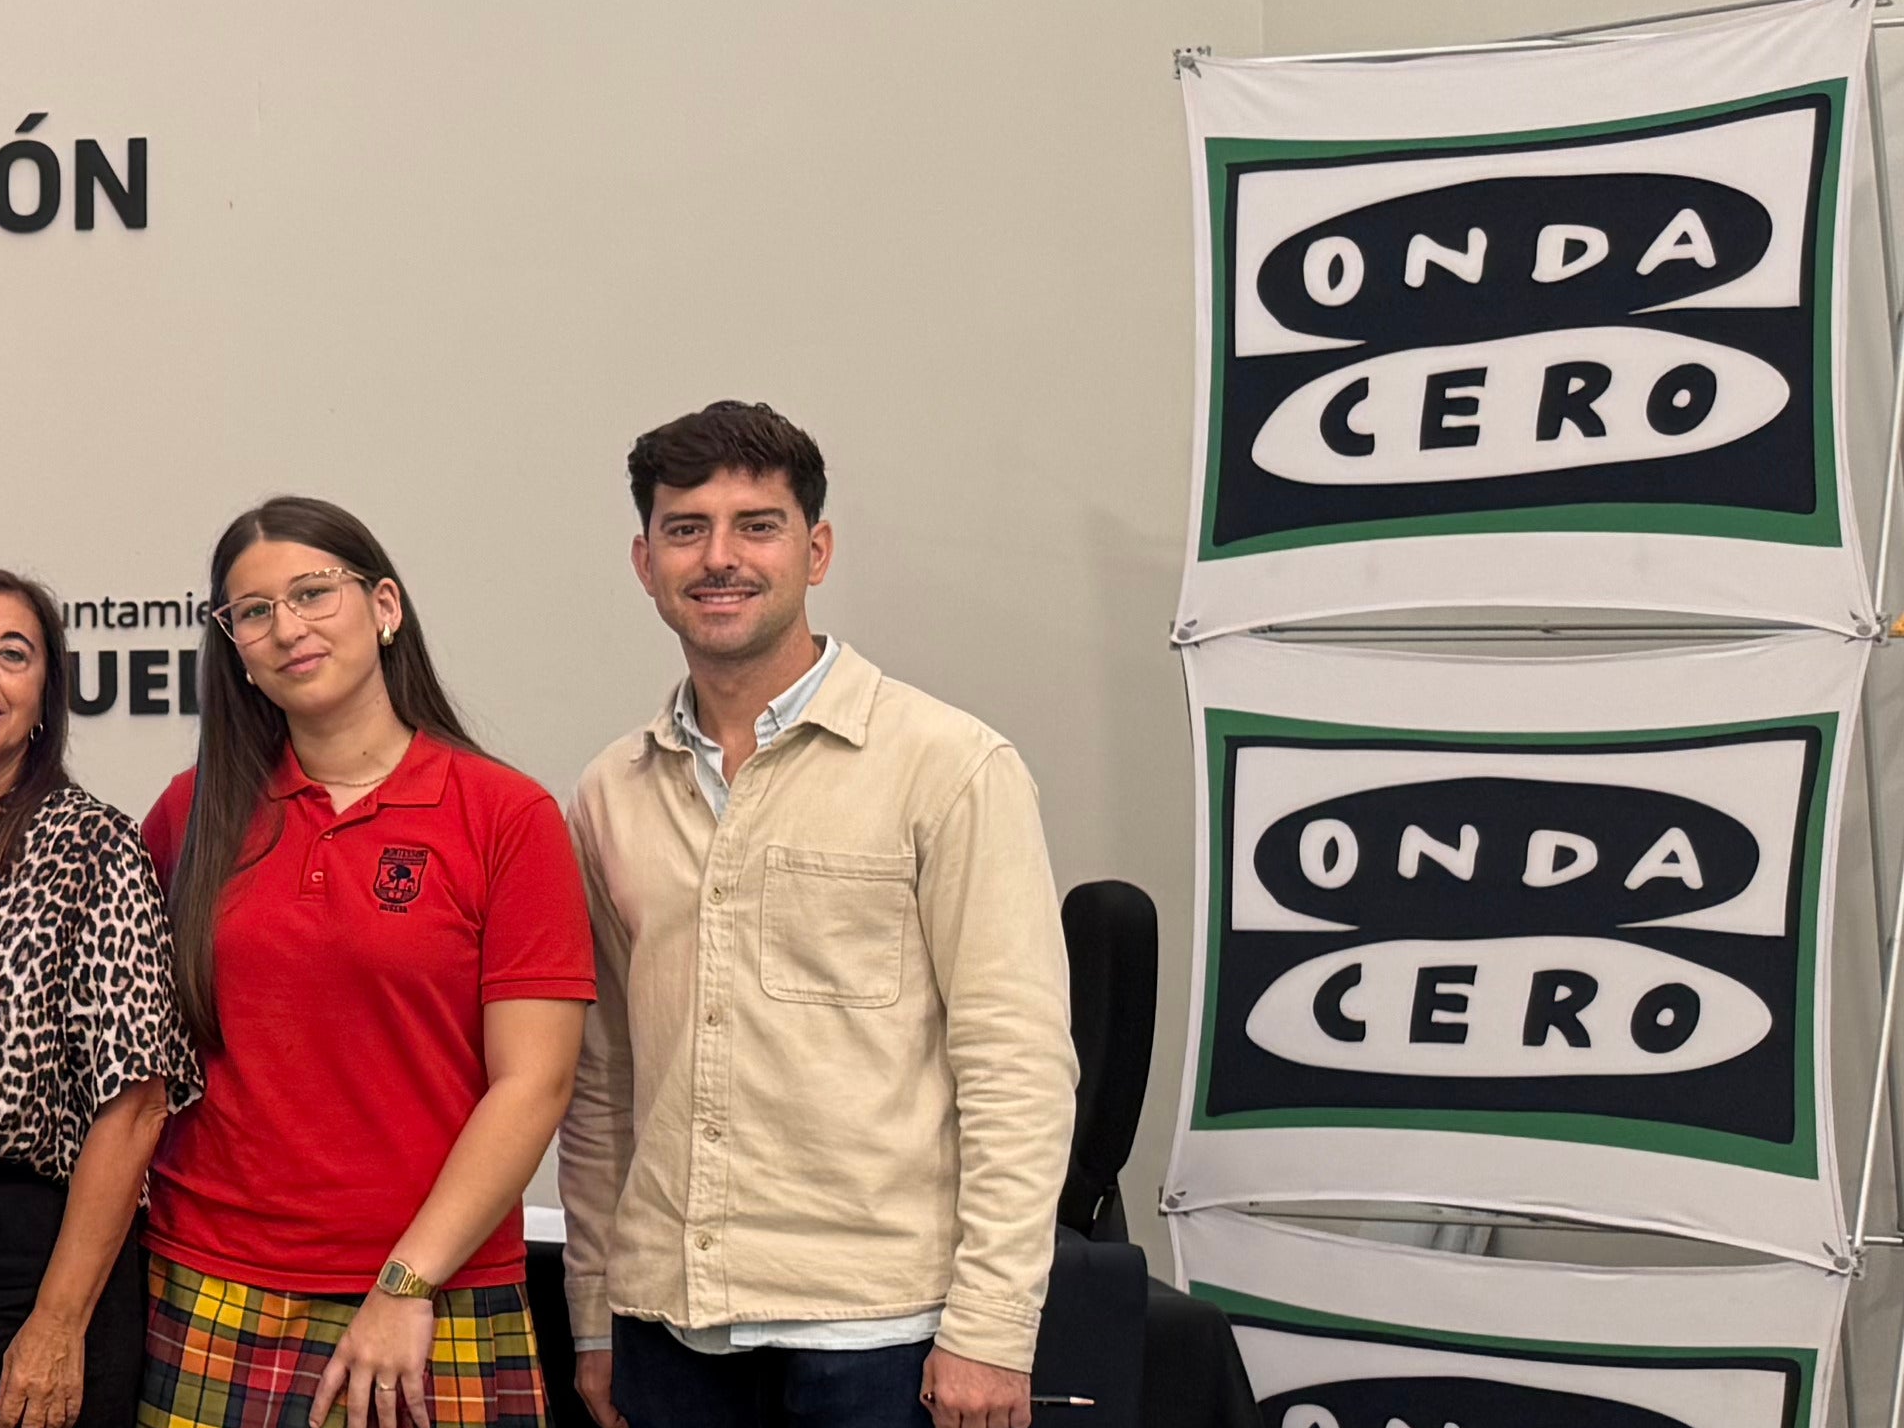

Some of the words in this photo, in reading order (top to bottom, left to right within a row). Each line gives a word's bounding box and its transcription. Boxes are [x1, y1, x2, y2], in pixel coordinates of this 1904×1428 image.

[1303, 208, 1717, 306] ONDA
[1319, 360, 1718, 458] CERO
[1299, 818, 1704, 890] ONDA
[1312, 962, 1701, 1054] CERO
